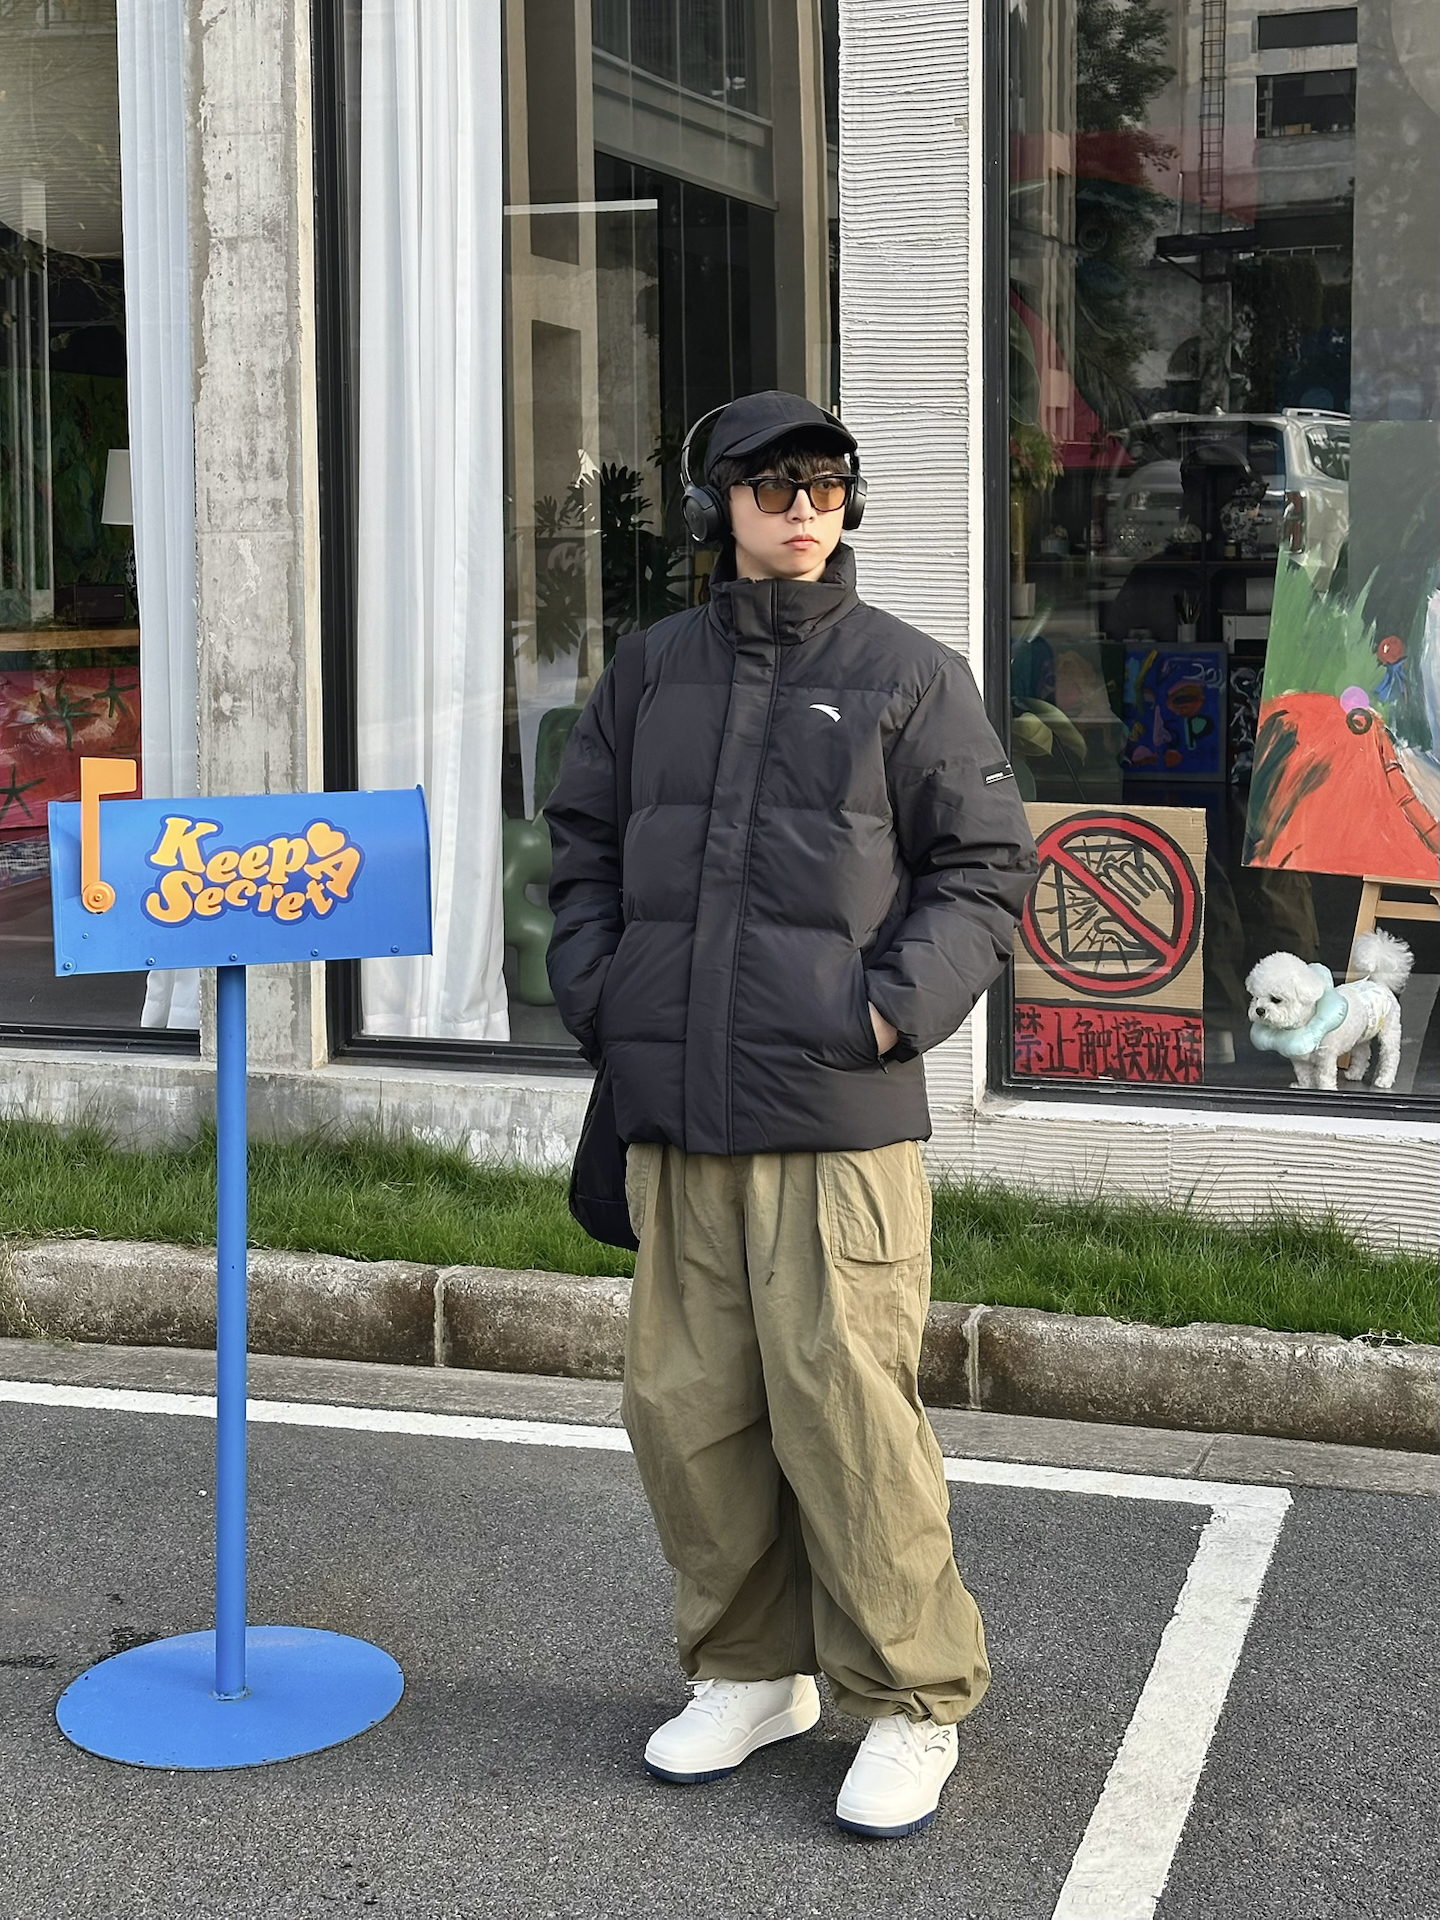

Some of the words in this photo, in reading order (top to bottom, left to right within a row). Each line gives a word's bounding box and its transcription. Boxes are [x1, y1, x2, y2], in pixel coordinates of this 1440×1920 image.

[150, 816, 309, 883] Keep
[304, 846, 361, 898] A
[146, 870, 333, 923] Secret
[1014, 1006, 1202, 1083] 禁止触摸玻璃
